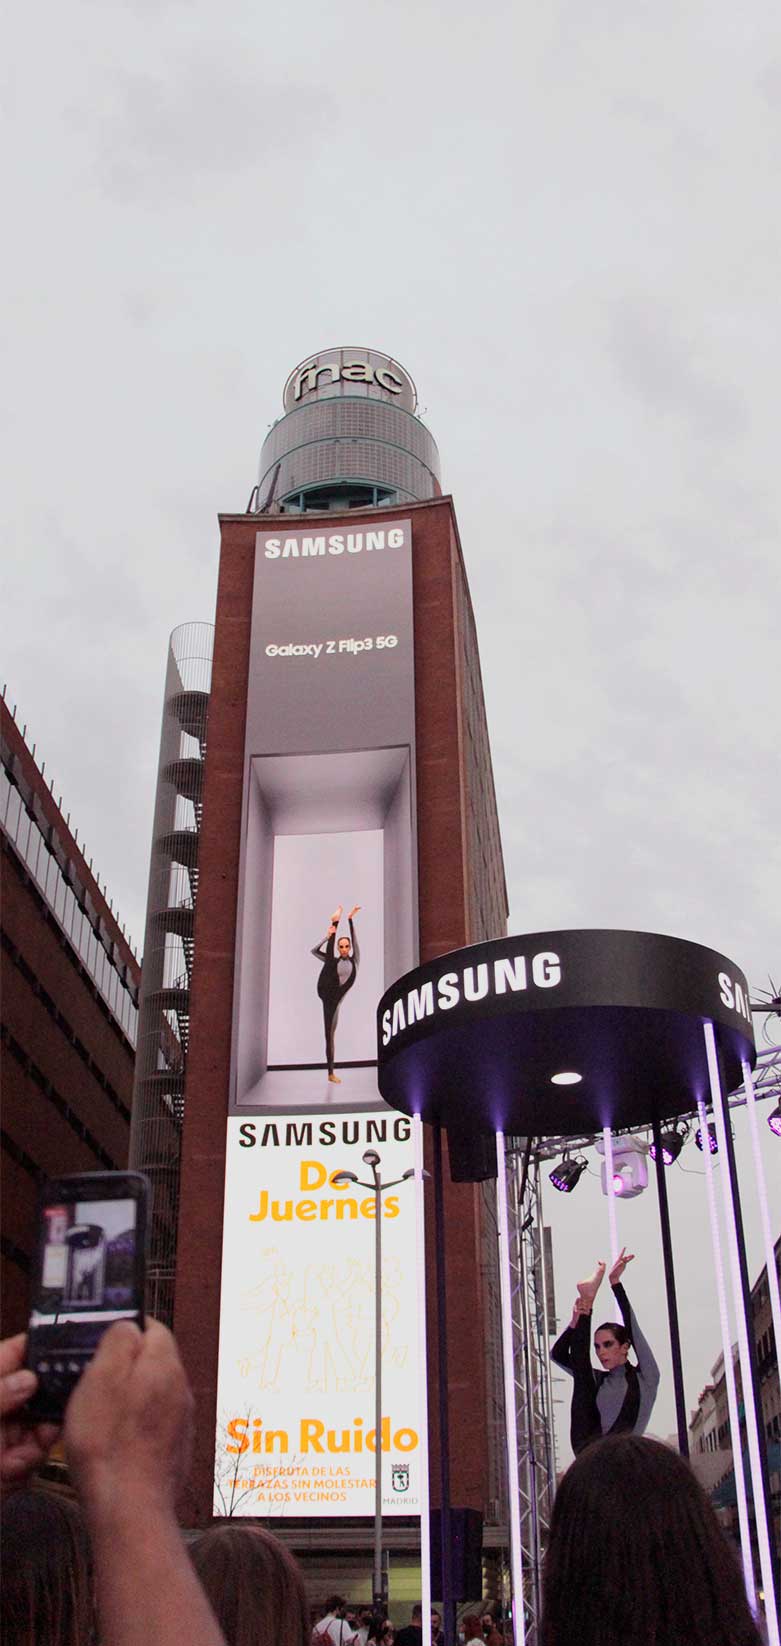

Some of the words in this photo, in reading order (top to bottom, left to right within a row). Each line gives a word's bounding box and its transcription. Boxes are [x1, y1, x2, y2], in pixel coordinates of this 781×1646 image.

[294, 360, 403, 401] fnac
[264, 528, 405, 559] SAMSUNG
[265, 642, 323, 658] Galaxy
[326, 641, 336, 653] Z
[338, 638, 373, 655] Flip3
[376, 635, 398, 650] 5G
[381, 951, 562, 1047] SAMSUNG
[717, 972, 750, 1022] SA
[238, 1117, 412, 1148] SAMSUNG
[249, 1190, 400, 1223] Juernes
[226, 1418, 289, 1454] Sin
[300, 1417, 420, 1454] Ruido
[228, 1479, 289, 1489] TERRAZAS
[291, 1479, 311, 1489] SIN
[313, 1479, 377, 1489] MOLESTAR
[253, 1465, 309, 1477] DISFRUTA
[311, 1465, 326, 1476] DE
[329, 1465, 351, 1476] LAS
[257, 1492, 265, 1502] A
[269, 1492, 291, 1502] LOS
[294, 1492, 347, 1502] VECINOS
[383, 1497, 418, 1505] MADRID
